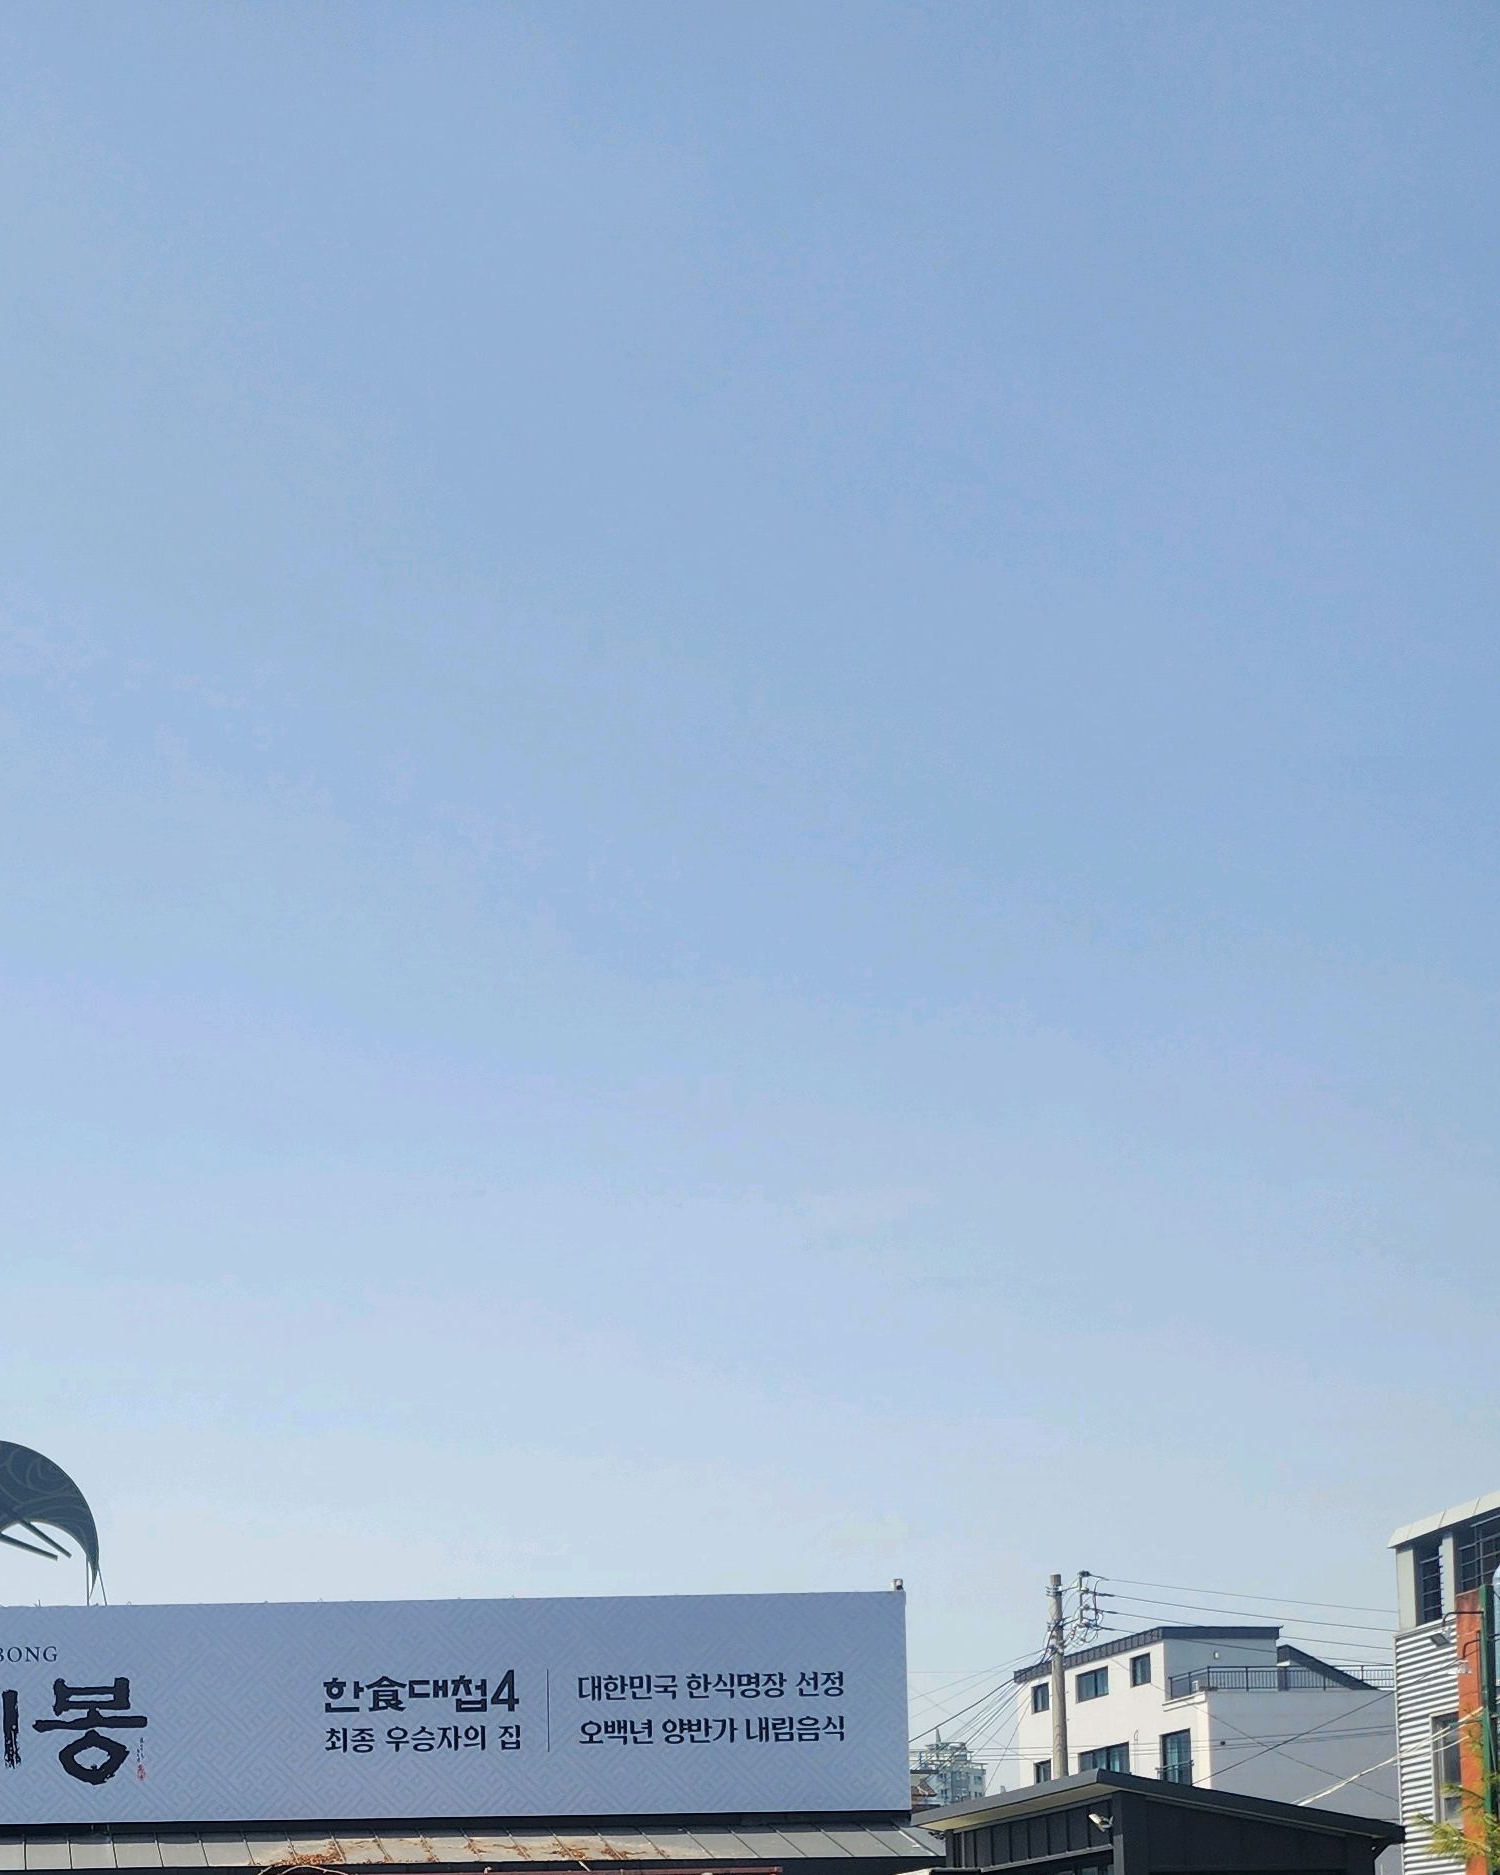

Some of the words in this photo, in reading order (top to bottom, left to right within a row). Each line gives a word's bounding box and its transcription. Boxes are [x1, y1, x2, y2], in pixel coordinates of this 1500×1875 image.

[323, 1669, 520, 1713] 한食대첩4
[577, 1674, 678, 1702] 대한민국
[685, 1672, 788, 1699] 한식명장
[795, 1670, 845, 1698] 선정
[324, 1726, 376, 1754] 최종
[385, 1725, 486, 1753] 우승자의
[498, 1724, 521, 1751] 집
[579, 1718, 654, 1746] 오백년
[661, 1717, 739, 1745] 양반가
[745, 1715, 845, 1743] 내림음식
